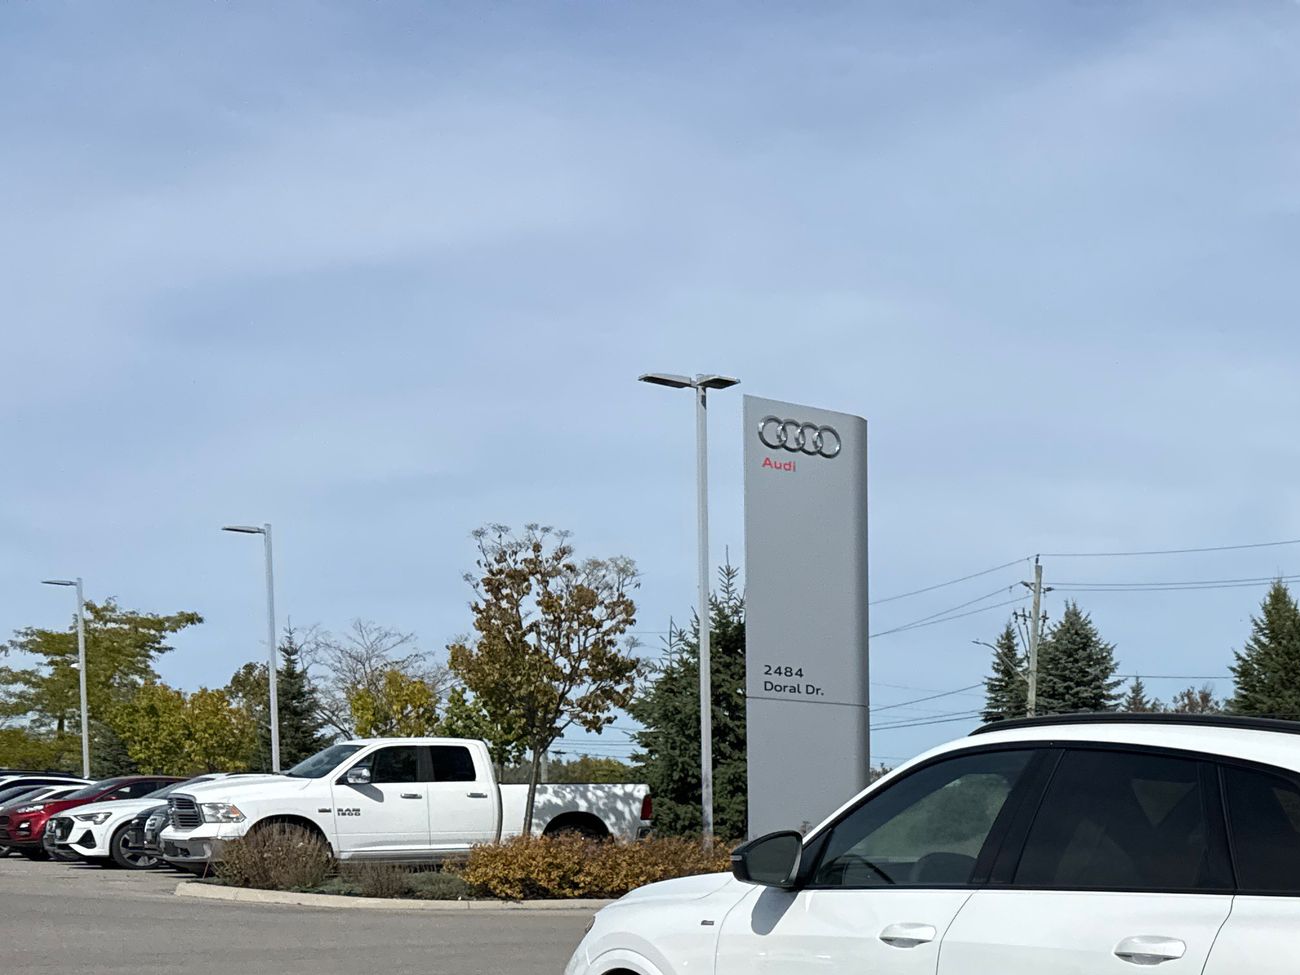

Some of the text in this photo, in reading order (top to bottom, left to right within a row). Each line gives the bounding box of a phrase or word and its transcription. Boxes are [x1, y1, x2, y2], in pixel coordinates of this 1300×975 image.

[762, 457, 796, 472] Audi
[764, 664, 804, 678] 2484
[764, 681, 824, 696] Doral Dr.
